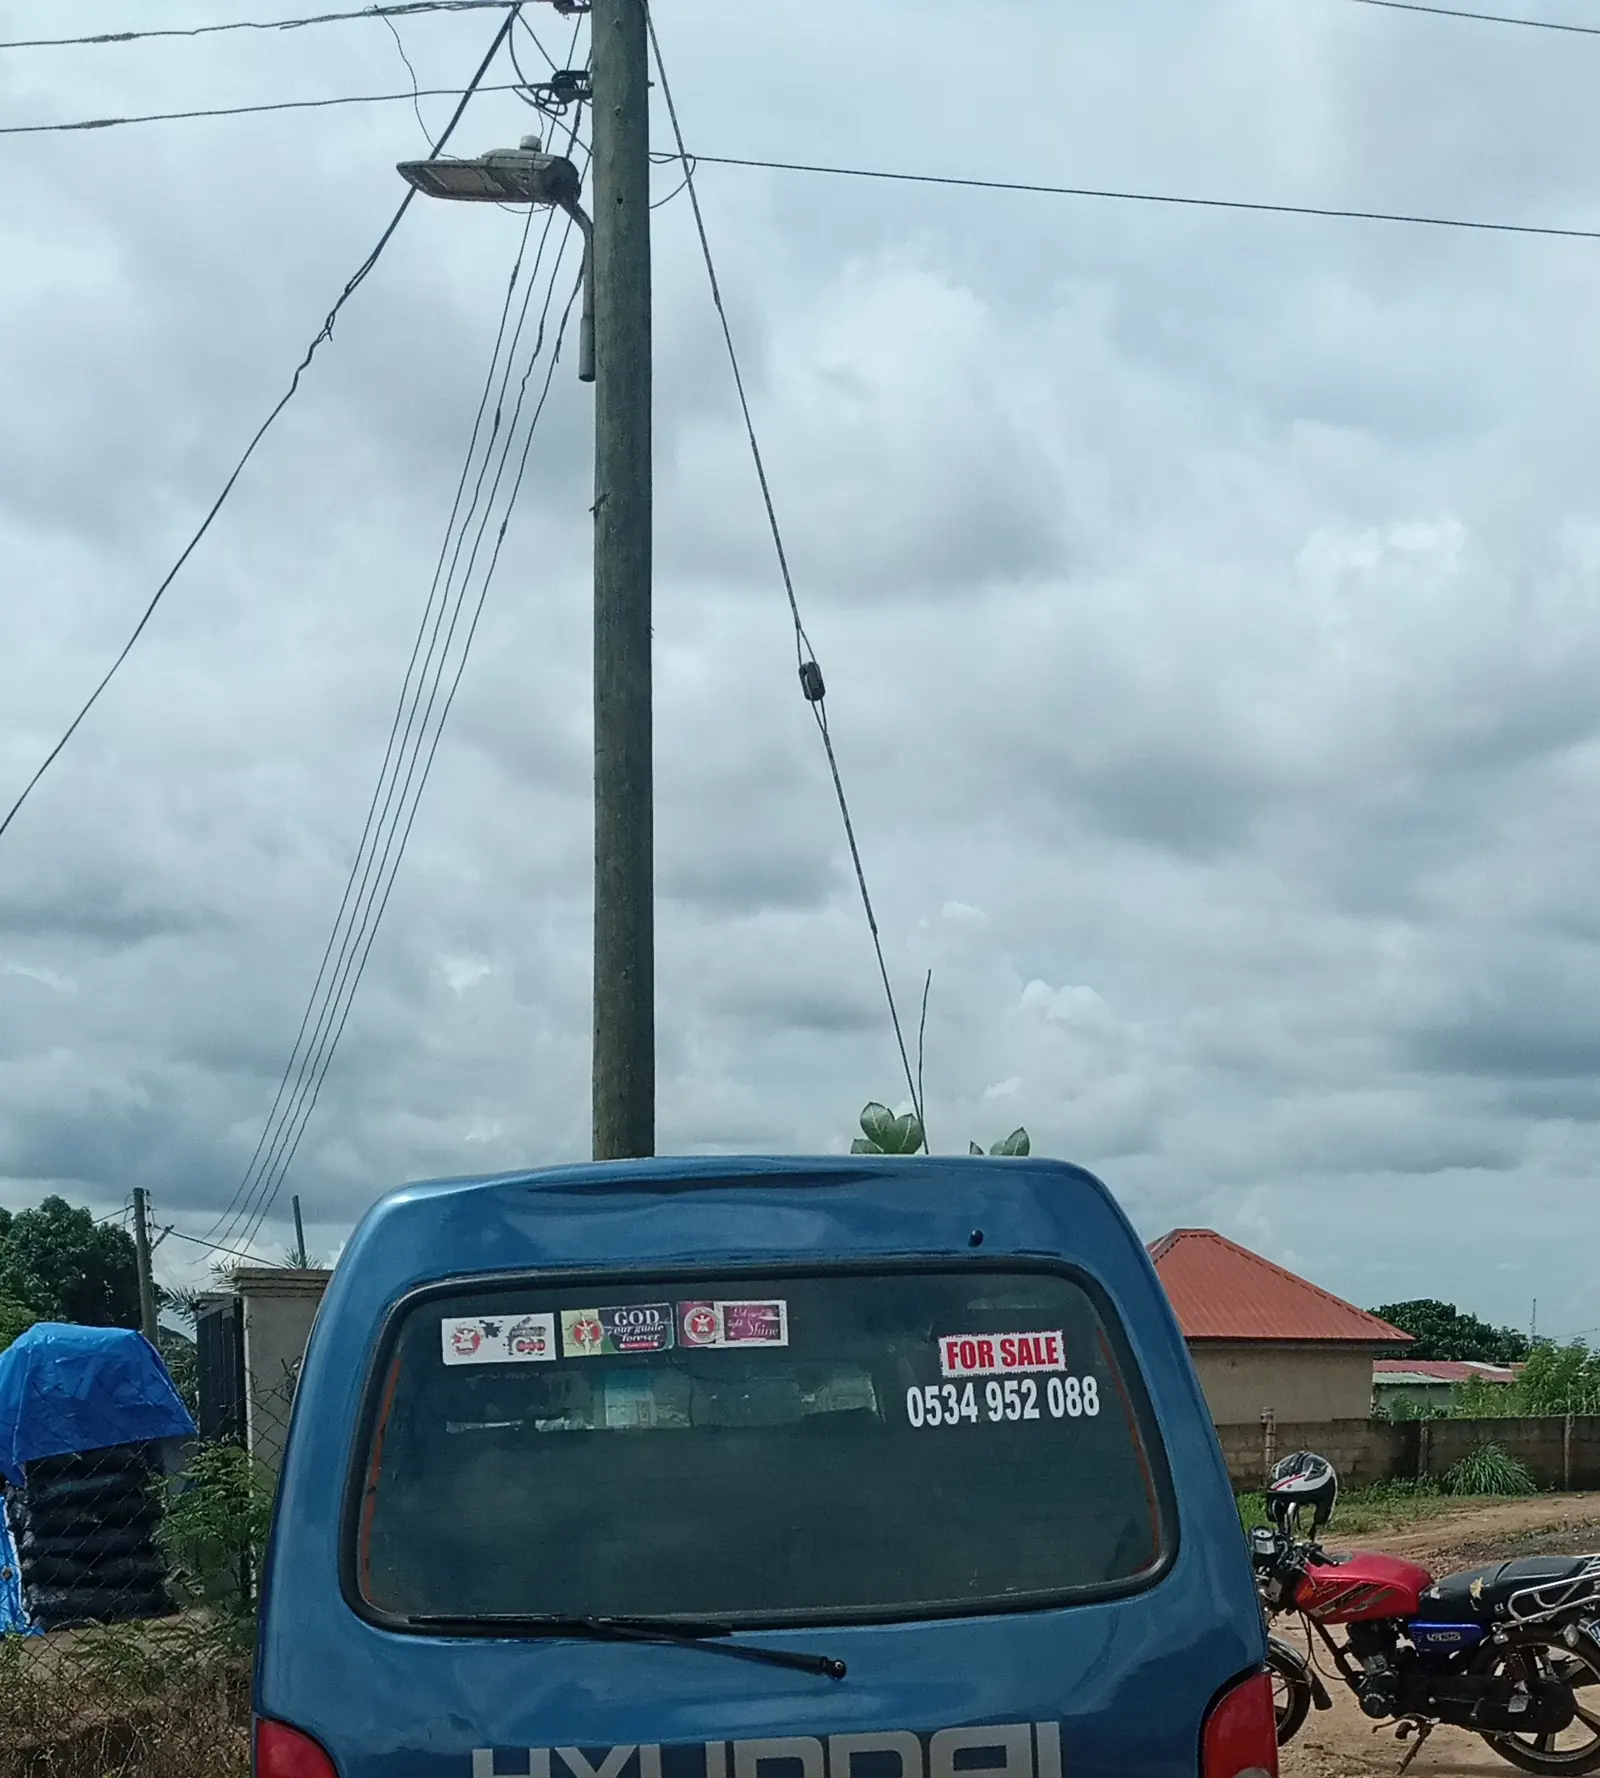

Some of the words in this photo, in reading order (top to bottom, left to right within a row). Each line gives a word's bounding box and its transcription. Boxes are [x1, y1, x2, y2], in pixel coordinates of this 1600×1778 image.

[614, 1310, 660, 1326] GOD
[946, 1339, 995, 1370] FOR
[1000, 1336, 1060, 1368] SALE
[907, 1382, 978, 1427] 0534
[985, 1378, 1040, 1422] 952
[1047, 1375, 1100, 1418] 088
